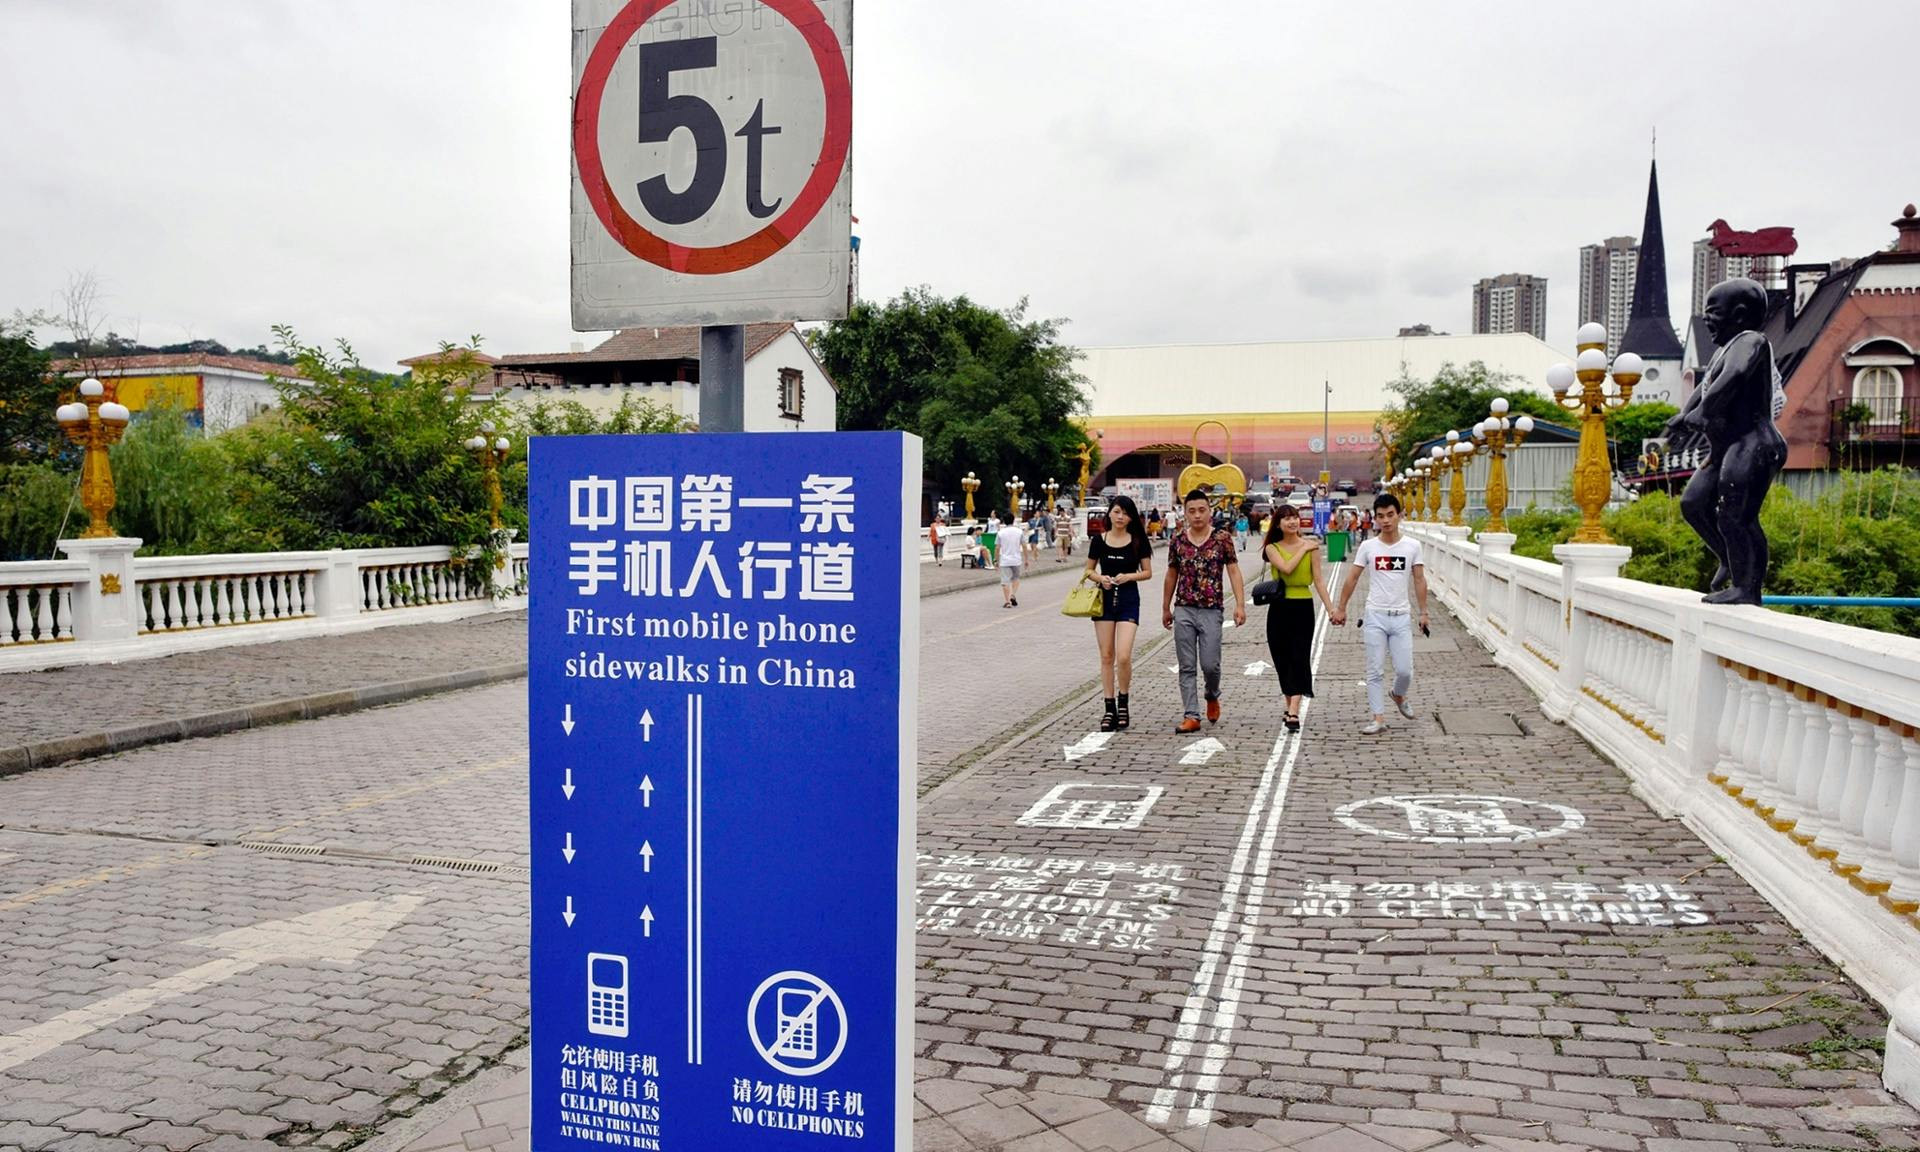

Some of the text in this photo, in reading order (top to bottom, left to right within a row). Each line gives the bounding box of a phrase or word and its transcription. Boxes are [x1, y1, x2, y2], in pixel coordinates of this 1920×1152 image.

[637, 36, 783, 225] 5t
[569, 474, 855, 533] 中国第一条
[568, 540, 855, 601] 手机人行道
[566, 608, 857, 648] First mobile phone
[565, 651, 856, 689] sidewalks in China
[926, 905, 1158, 935] IN THIS LANE
[1291, 899, 1709, 926] NO CELLPHONES
[1058, 927, 1157, 951] RISK
[561, 1043, 659, 1077] 允许使用手机
[561, 1067, 659, 1102] 但风险自负
[733, 1077, 864, 1116] 请勿使用手机
[561, 1092, 660, 1121] CELLPHONES
[561, 1110, 660, 1136] WALK IN THIS LANE
[731, 1105, 864, 1139] NO CELLPHONES
[560, 1125, 660, 1151] AT YOUR OWN RISK
